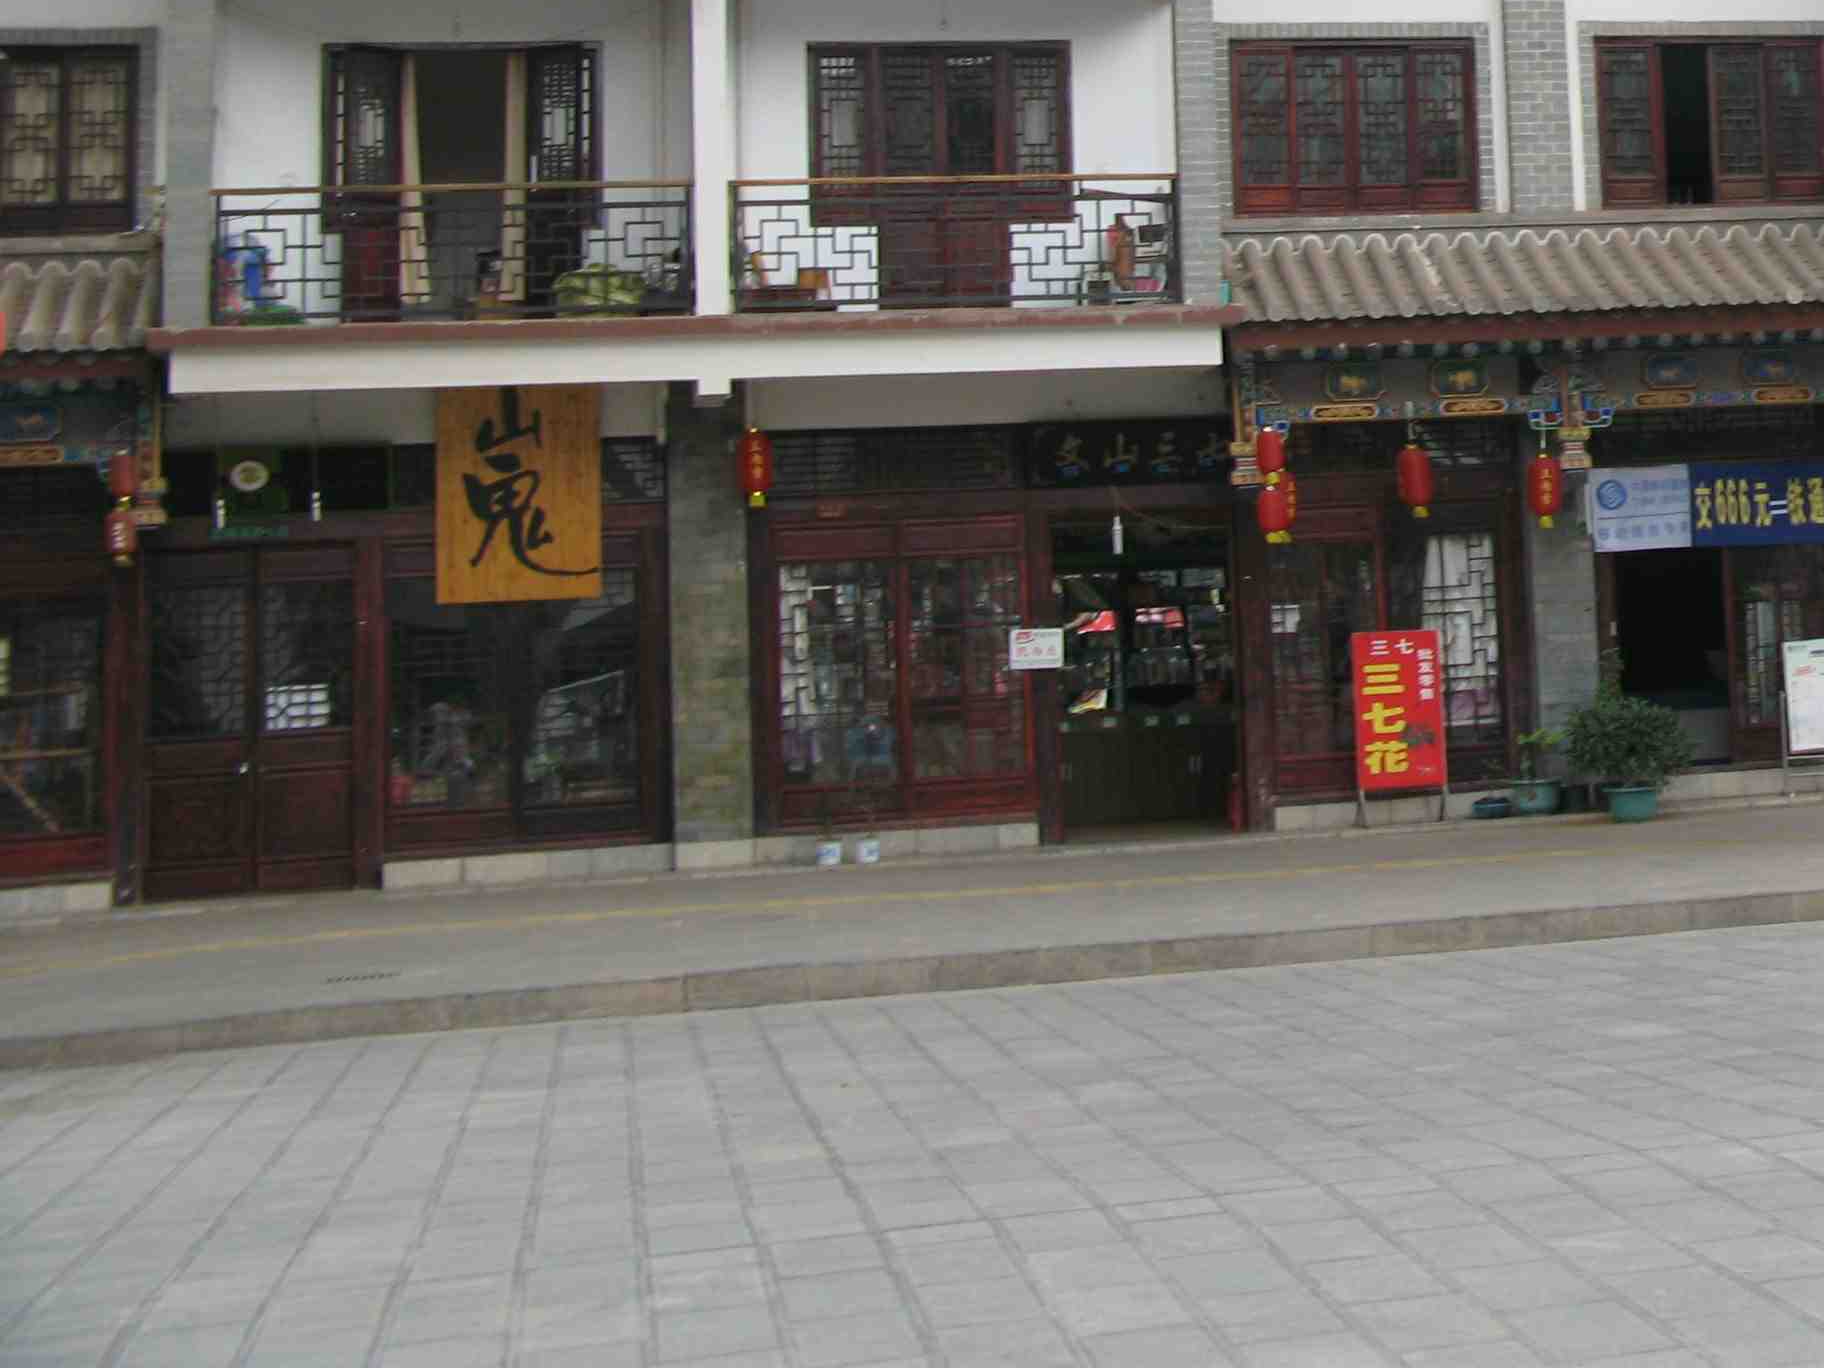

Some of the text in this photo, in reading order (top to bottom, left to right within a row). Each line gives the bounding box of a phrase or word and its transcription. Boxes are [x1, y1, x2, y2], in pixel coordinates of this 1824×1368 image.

[461, 386, 600, 576] 山鬼
[1369, 638, 1415, 656] 三七
[1361, 663, 1410, 775] 三七花
